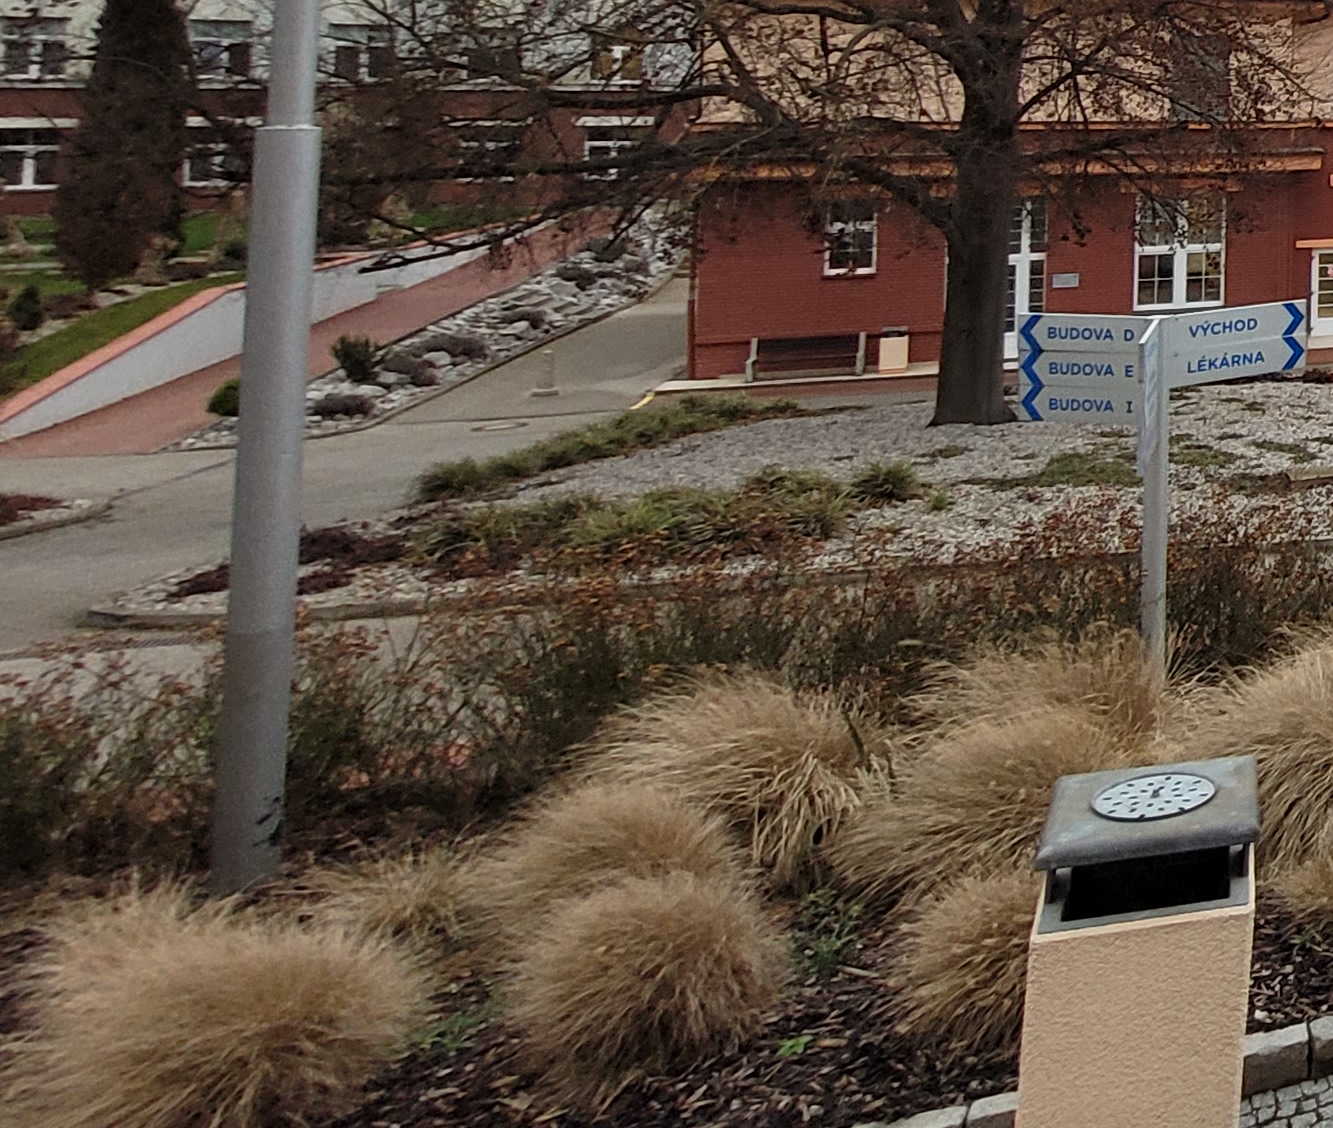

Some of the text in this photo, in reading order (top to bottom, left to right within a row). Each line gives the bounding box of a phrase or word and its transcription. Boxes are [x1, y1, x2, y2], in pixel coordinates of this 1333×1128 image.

[1047, 326, 1134, 342] BUDOVA D
[1188, 318, 1258, 338] VÝCHOD
[1048, 361, 1134, 378] BUDOVA E
[1187, 351, 1265, 374] LÉKÁRNA
[1048, 398, 1133, 413] BUDOVA I
